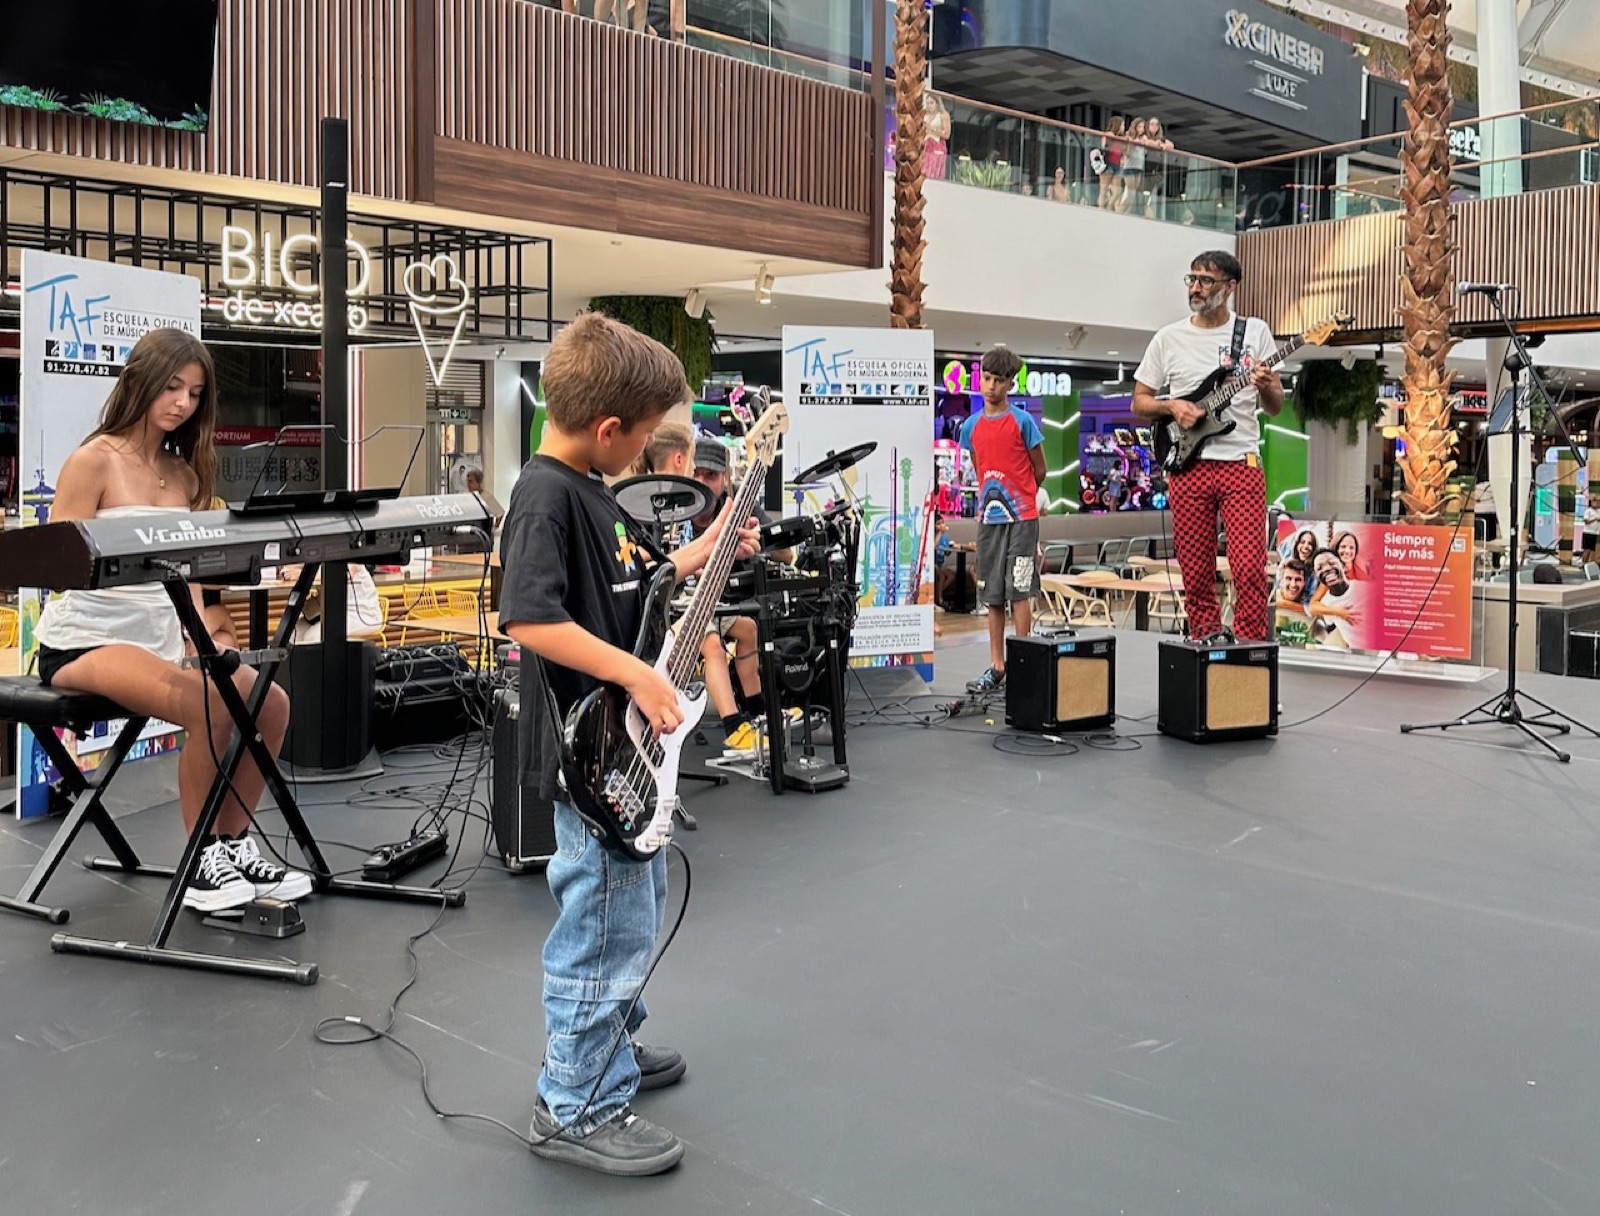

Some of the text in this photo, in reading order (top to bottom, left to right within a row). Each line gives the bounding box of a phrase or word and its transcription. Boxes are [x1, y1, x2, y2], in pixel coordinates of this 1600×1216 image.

[1249, 21, 1324, 75] CINESA
[1262, 74, 1298, 97] LUXE
[25, 274, 110, 347] TAF
[223, 289, 367, 330] de xeao
[103, 311, 194, 332] ESCUELA OFICIAL
[104, 324, 115, 336] DE
[785, 337, 854, 386] TAF
[848, 361, 927, 370] ESCUELA OFICIAL
[860, 369, 888, 377] MÚSICA
[212, 431, 251, 440] PORTIUM
[415, 501, 464, 518] Roland
[1384, 532, 1435, 547] Siempre
[1384, 545, 1434, 560] hay más
